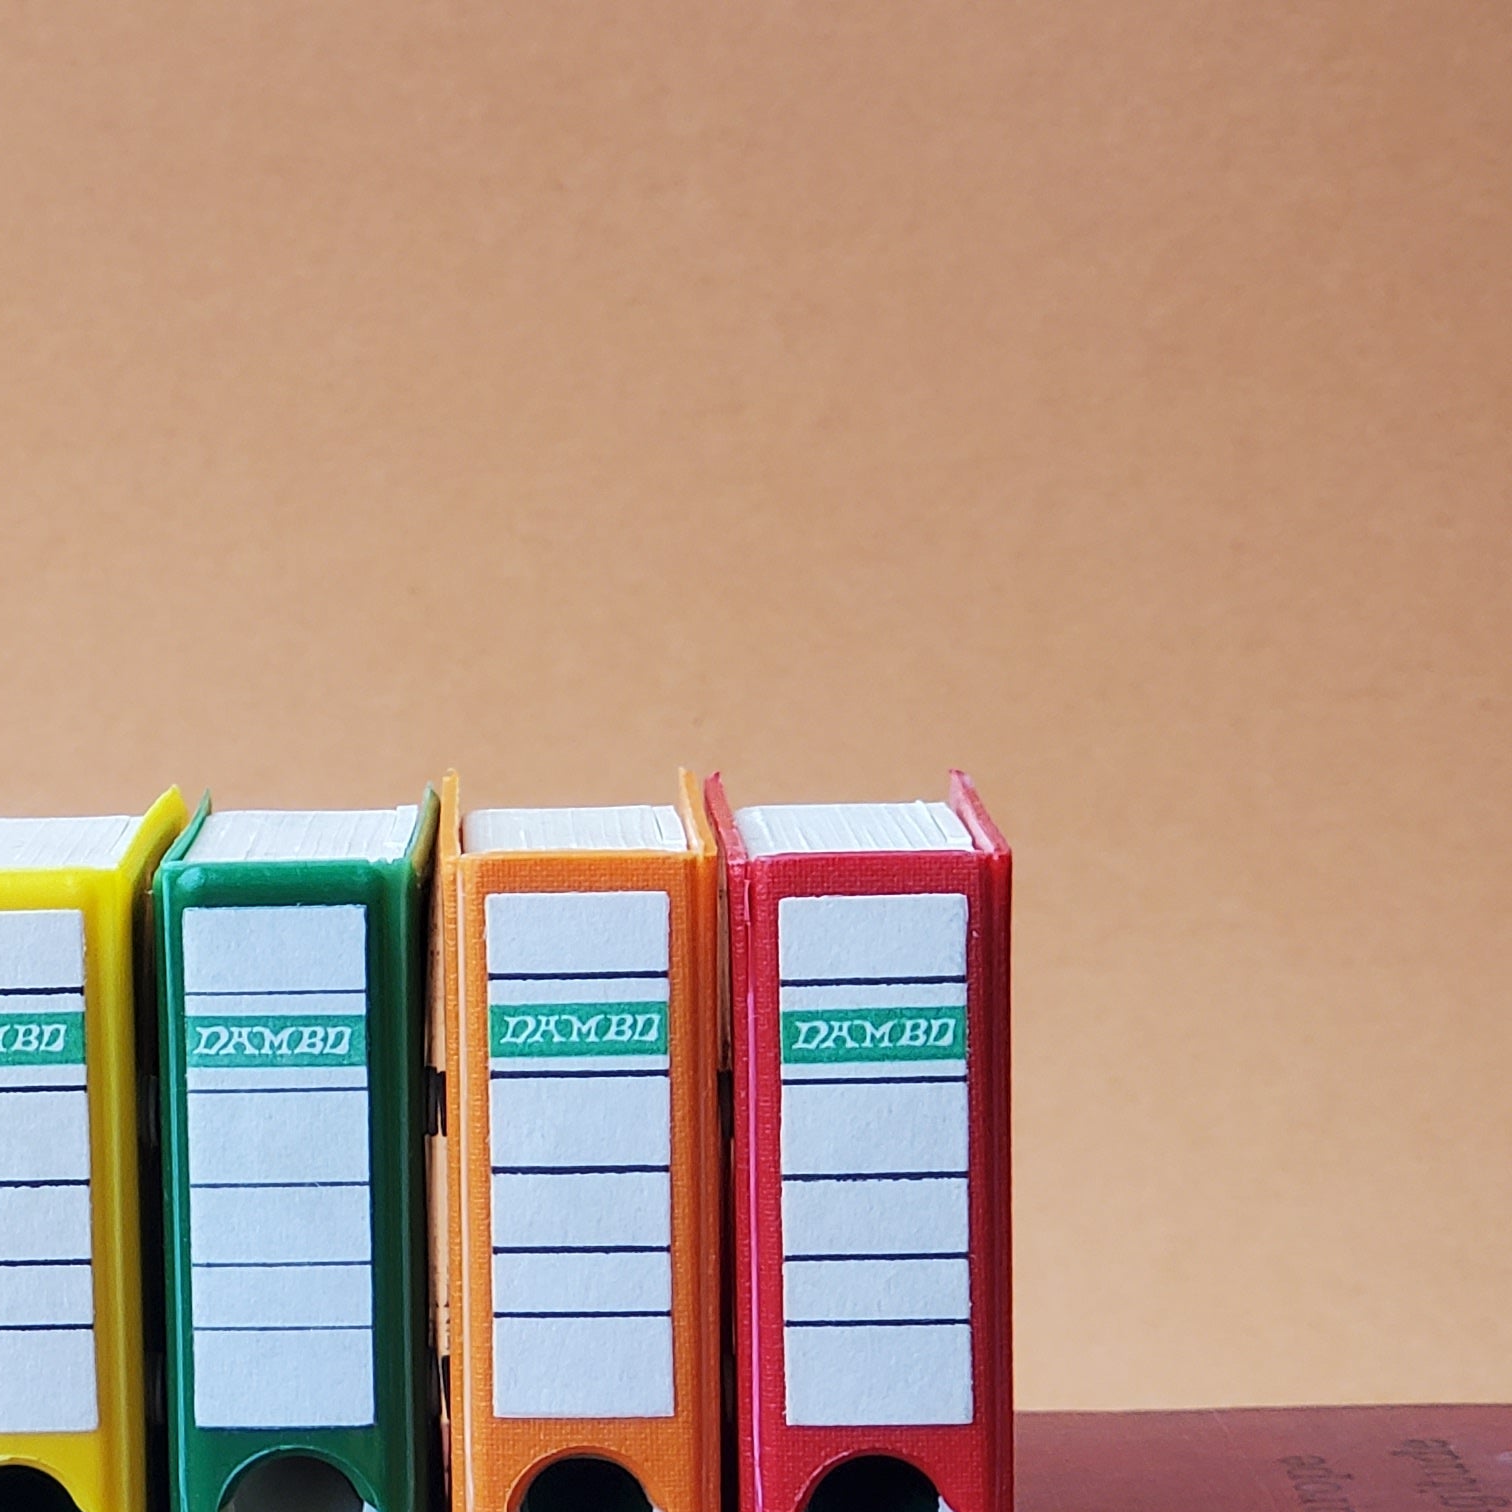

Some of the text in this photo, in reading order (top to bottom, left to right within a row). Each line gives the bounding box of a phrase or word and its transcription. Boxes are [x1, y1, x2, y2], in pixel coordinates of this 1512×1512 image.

[193, 1024, 351, 1057] DAMBO
[499, 1012, 662, 1046] DAMBO
[791, 1017, 958, 1051] DAMBO
